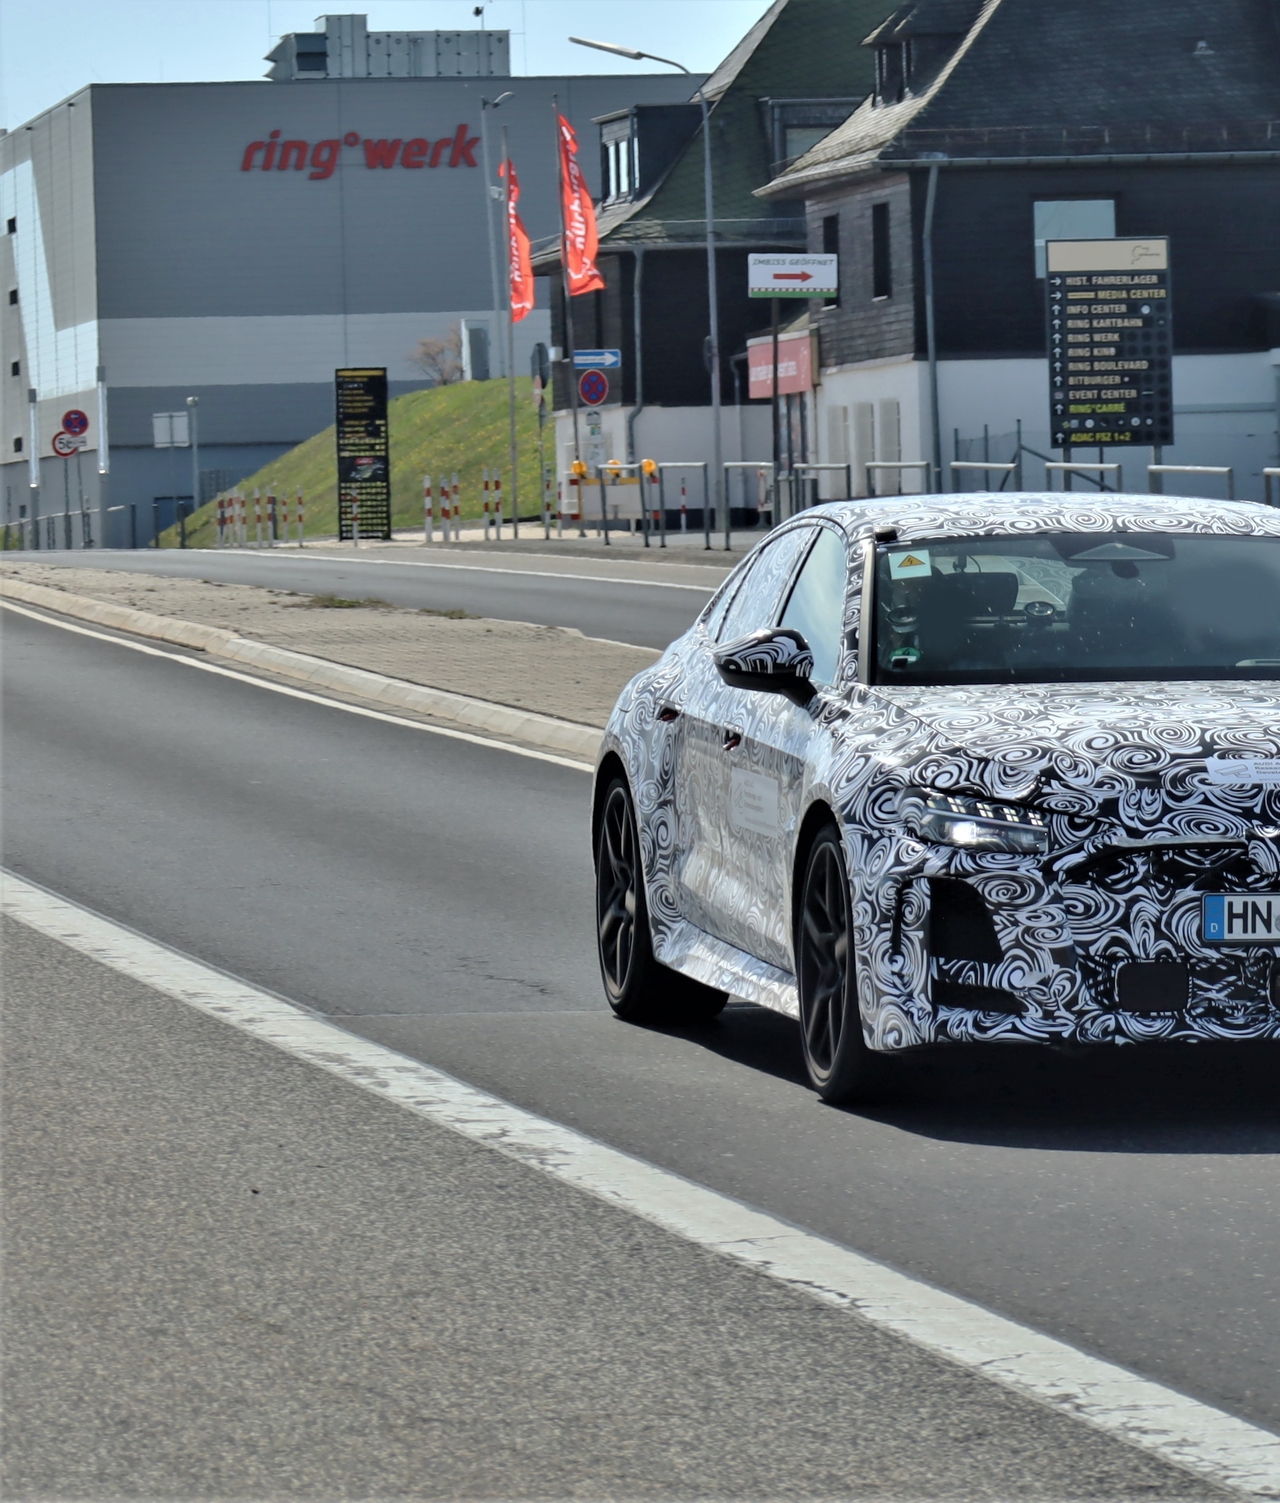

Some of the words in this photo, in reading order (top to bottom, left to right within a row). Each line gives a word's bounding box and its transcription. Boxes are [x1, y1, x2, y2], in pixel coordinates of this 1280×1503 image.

[752, 258, 787, 266] IMBISS
[788, 257, 835, 266] GEÖFFNET
[1066, 276, 1089, 286] HIST.
[1092, 275, 1159, 285] FAHRERLAGER
[1097, 290, 1128, 299] MEDIA
[1130, 289, 1166, 298] CENTER
[1066, 305, 1089, 314] INFO
[1091, 304, 1127, 314] CENTER
[1067, 319, 1090, 328] RING
[1092, 318, 1143, 327] KARTBAHN
[1067, 333, 1091, 342] RING
[1092, 333, 1120, 342] WERK
[1068, 348, 1091, 357] RING
[1068, 362, 1091, 371] RING
[1093, 360, 1149, 370] BOULEVARD
[1068, 375, 1121, 385] BITBURGER
[1069, 390, 1098, 399] EVENT
[1100, 389, 1137, 398] CENTER
[1070, 432, 1094, 442] ADAC
[1210, 922, 1219, 933] D
[1227, 900, 1272, 934] HN
